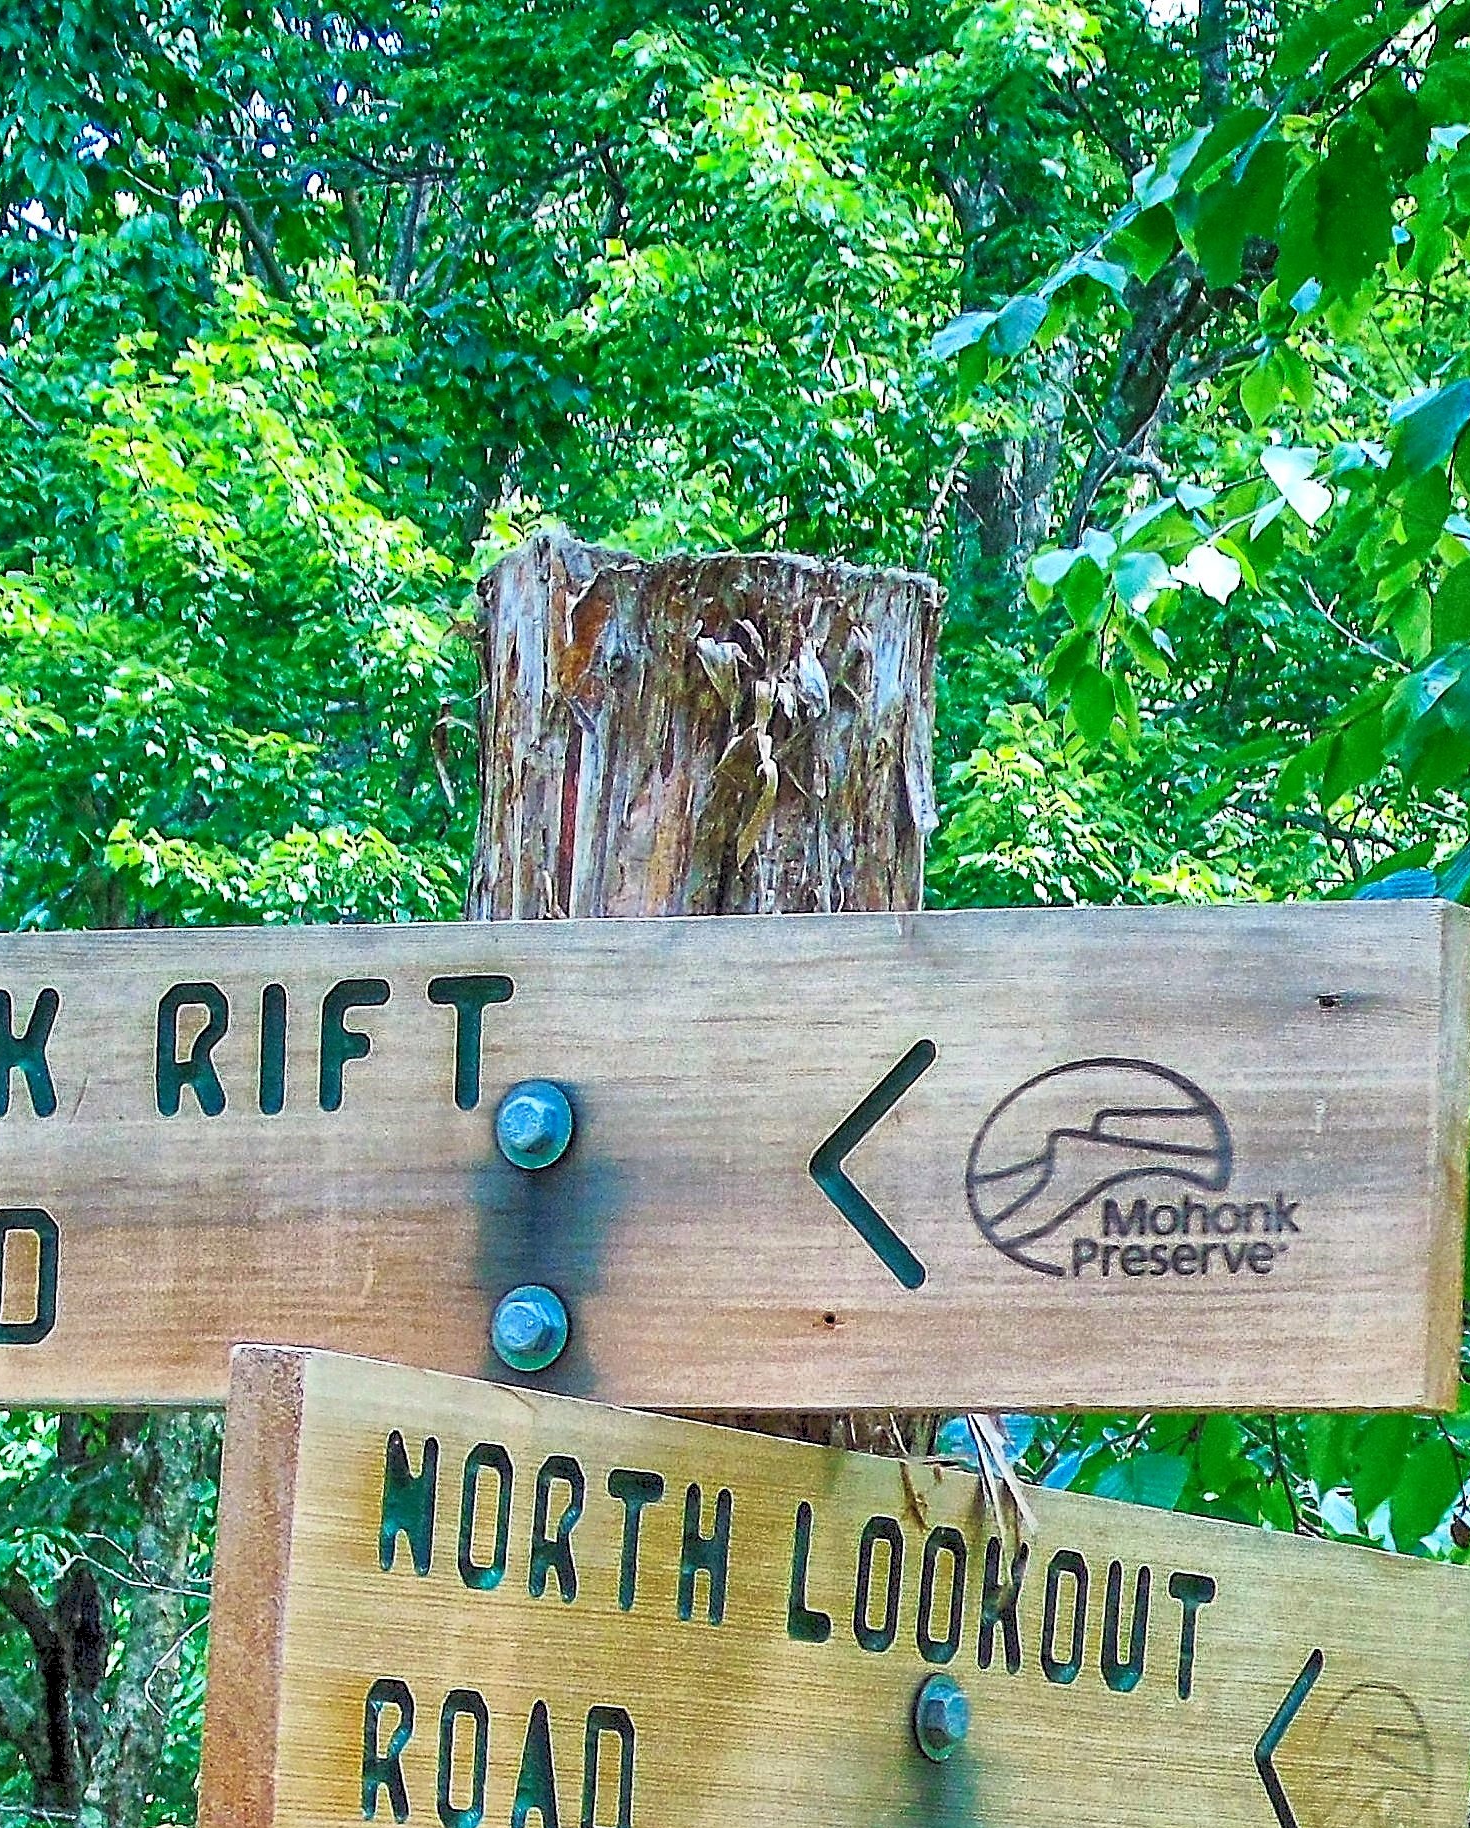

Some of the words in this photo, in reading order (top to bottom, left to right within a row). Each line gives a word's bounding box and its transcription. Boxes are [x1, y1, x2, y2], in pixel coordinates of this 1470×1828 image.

[154, 974, 515, 1118] RIFT
[1101, 1193, 1300, 1238] Mohonk
[376, 1428, 734, 1628] NORTH
[786, 1499, 1218, 1701] LOOKOUT
